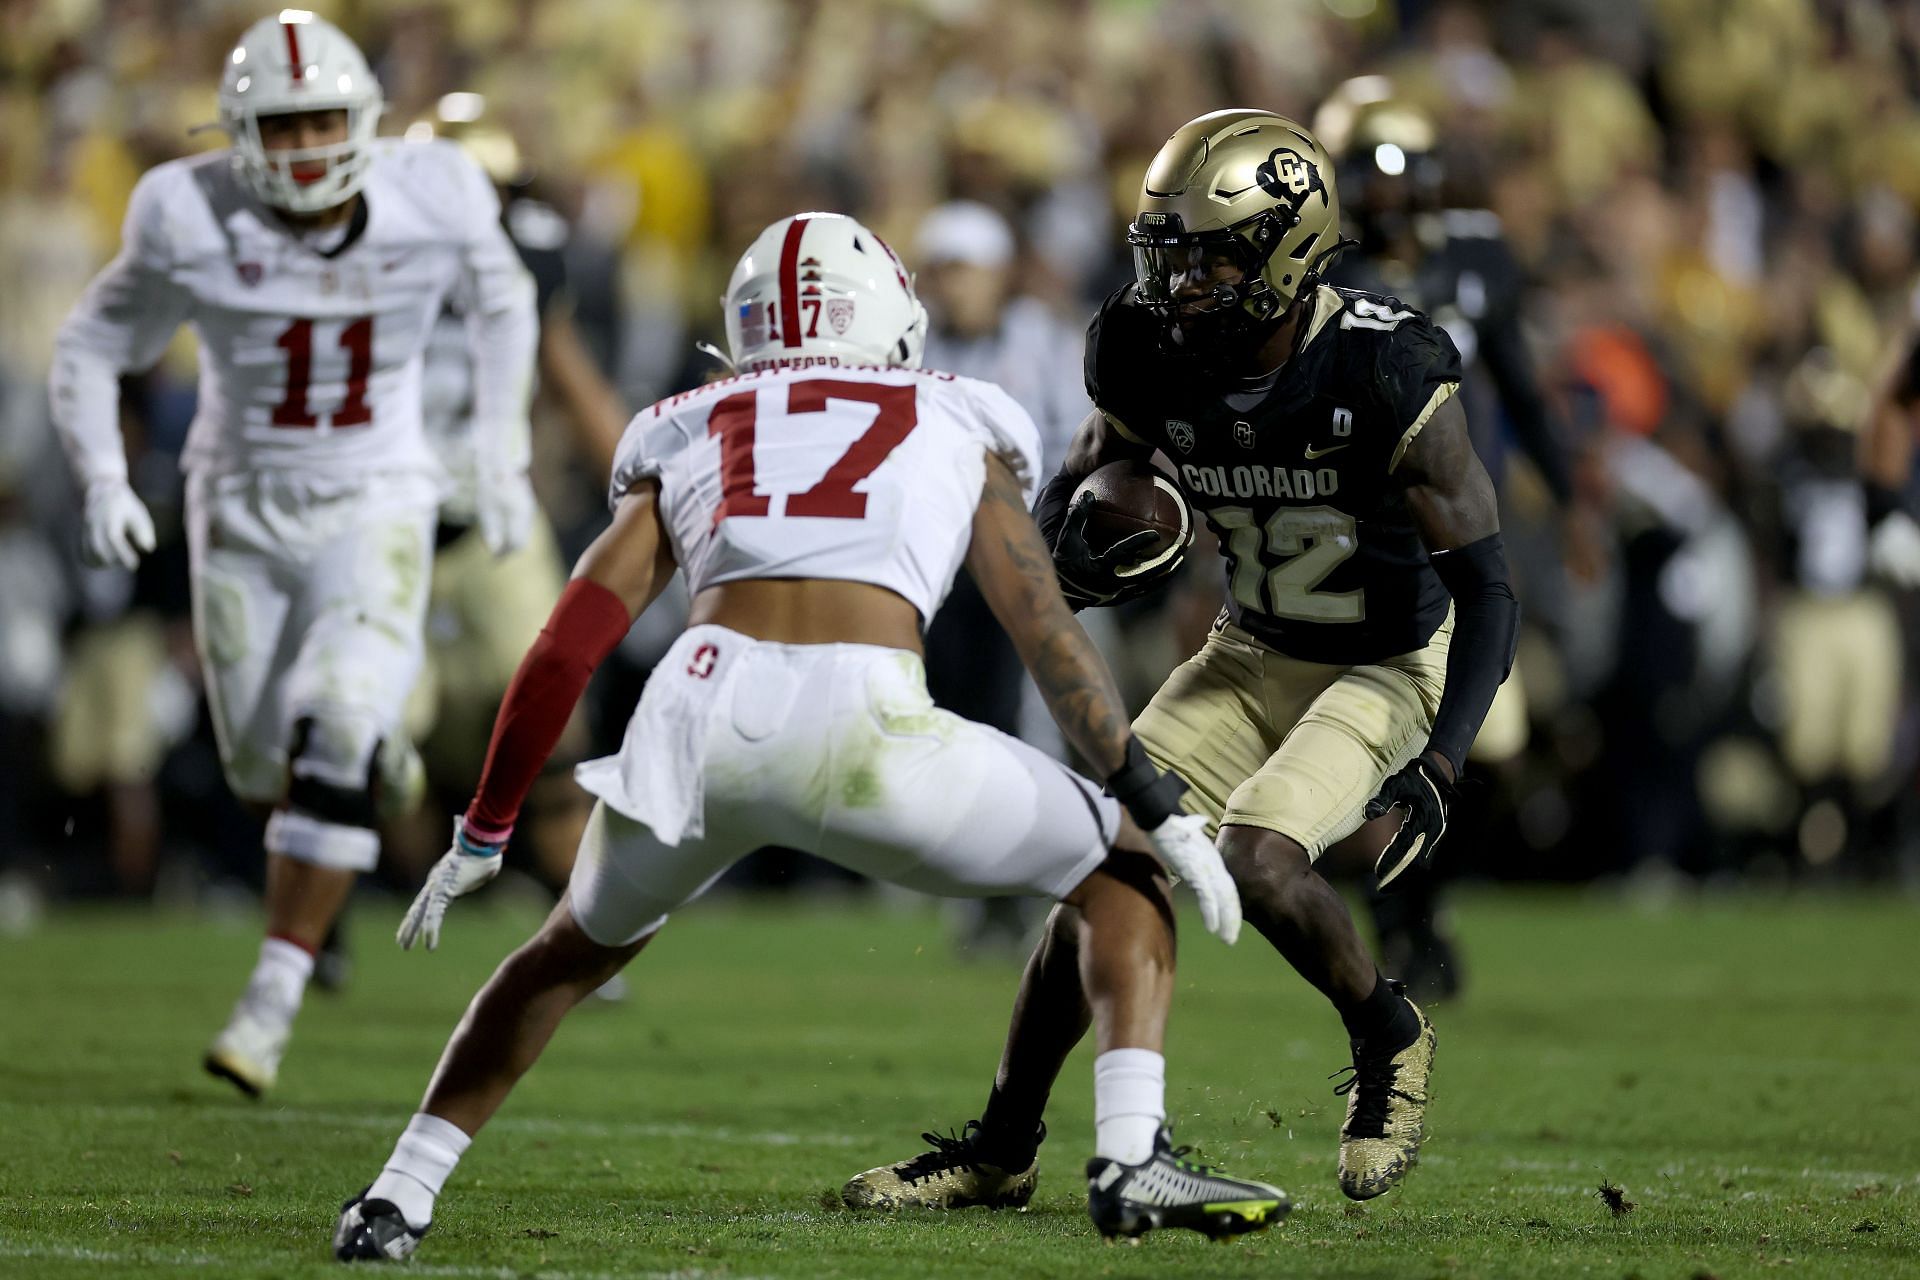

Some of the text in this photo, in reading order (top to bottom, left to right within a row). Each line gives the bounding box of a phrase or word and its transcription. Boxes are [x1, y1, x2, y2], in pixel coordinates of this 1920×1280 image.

[1274, 152, 1310, 194] CU
[271, 316, 374, 429] 11
[707, 379, 918, 530] 17
[1175, 435, 1191, 448] 12
[1181, 464, 1339, 499] COLORADO
[1209, 504, 1366, 624] 12
